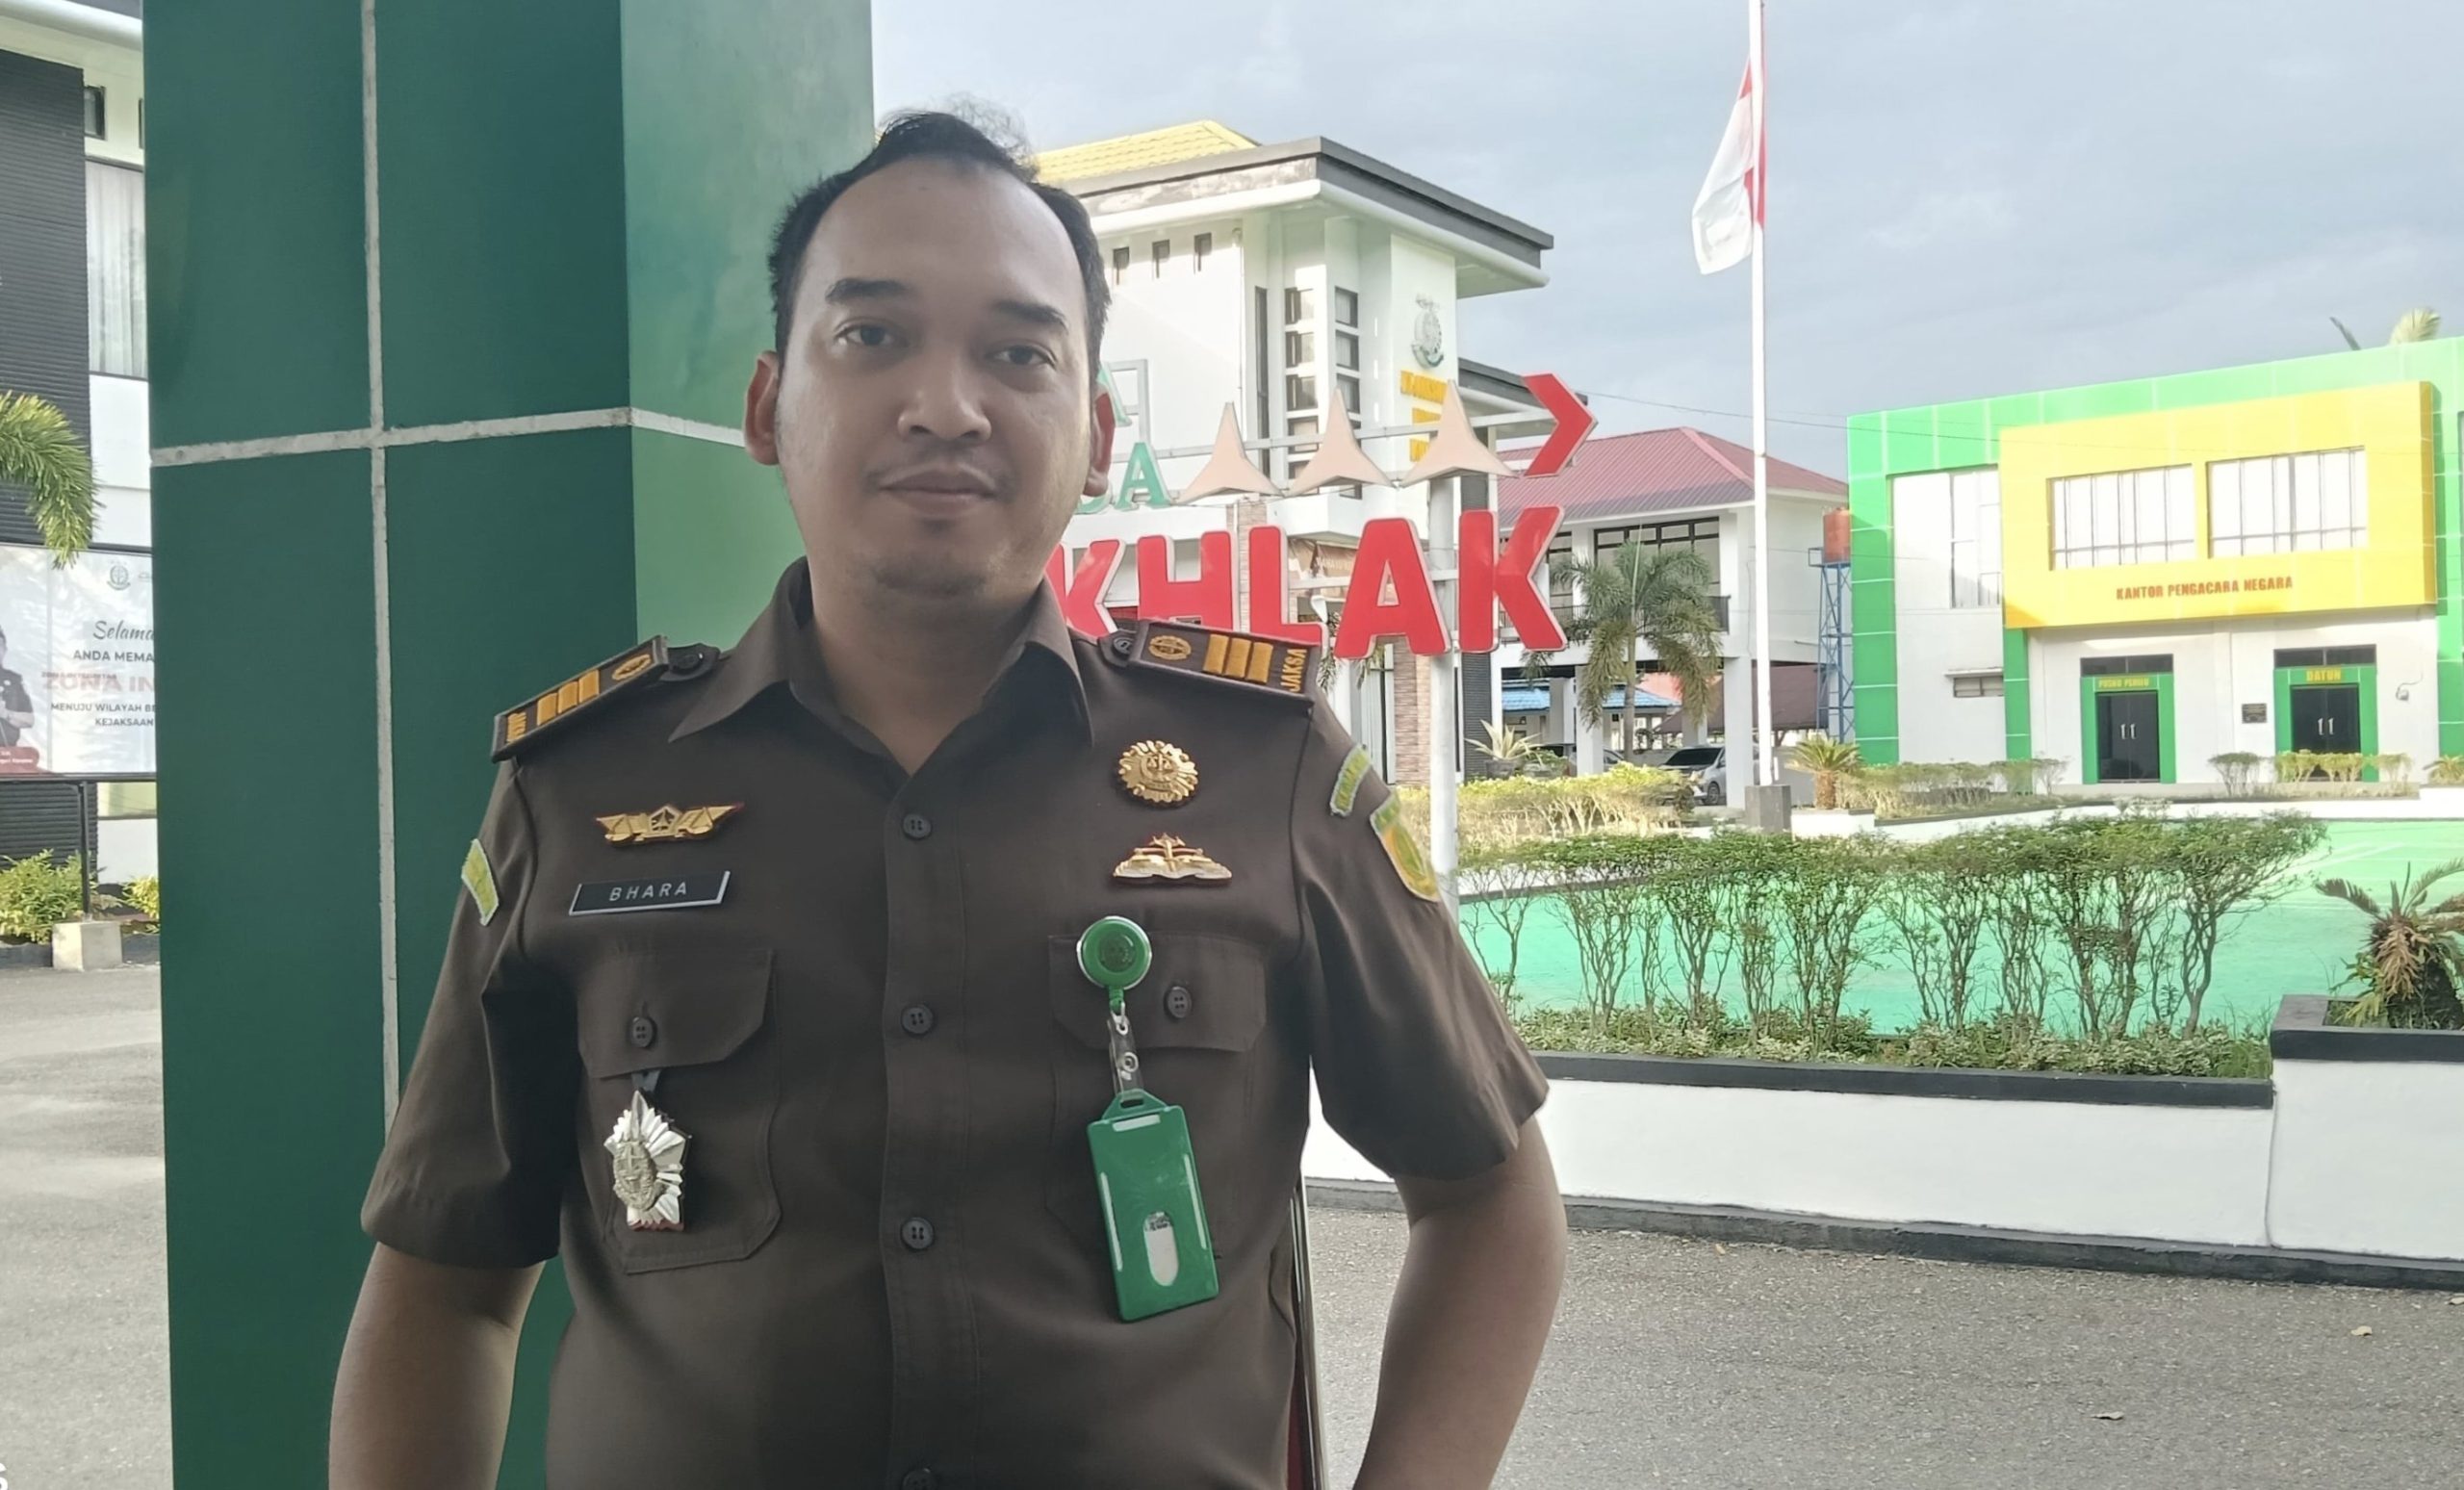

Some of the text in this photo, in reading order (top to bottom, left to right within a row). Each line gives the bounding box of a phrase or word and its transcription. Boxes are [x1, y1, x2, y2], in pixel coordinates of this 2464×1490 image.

[2117, 576, 2293, 600] KANTOR PENGACARA NEGARA
[73, 650, 154, 662] ANDA MEMA
[1280, 649, 1307, 692] JAKSA
[43, 675, 123, 692] ZONA
[51, 703, 92, 712] MENUJU
[95, 704, 141, 712] WILAYAH
[95, 718, 153, 727] KEJAKSAAN
[608, 881, 686, 902] BHARA
